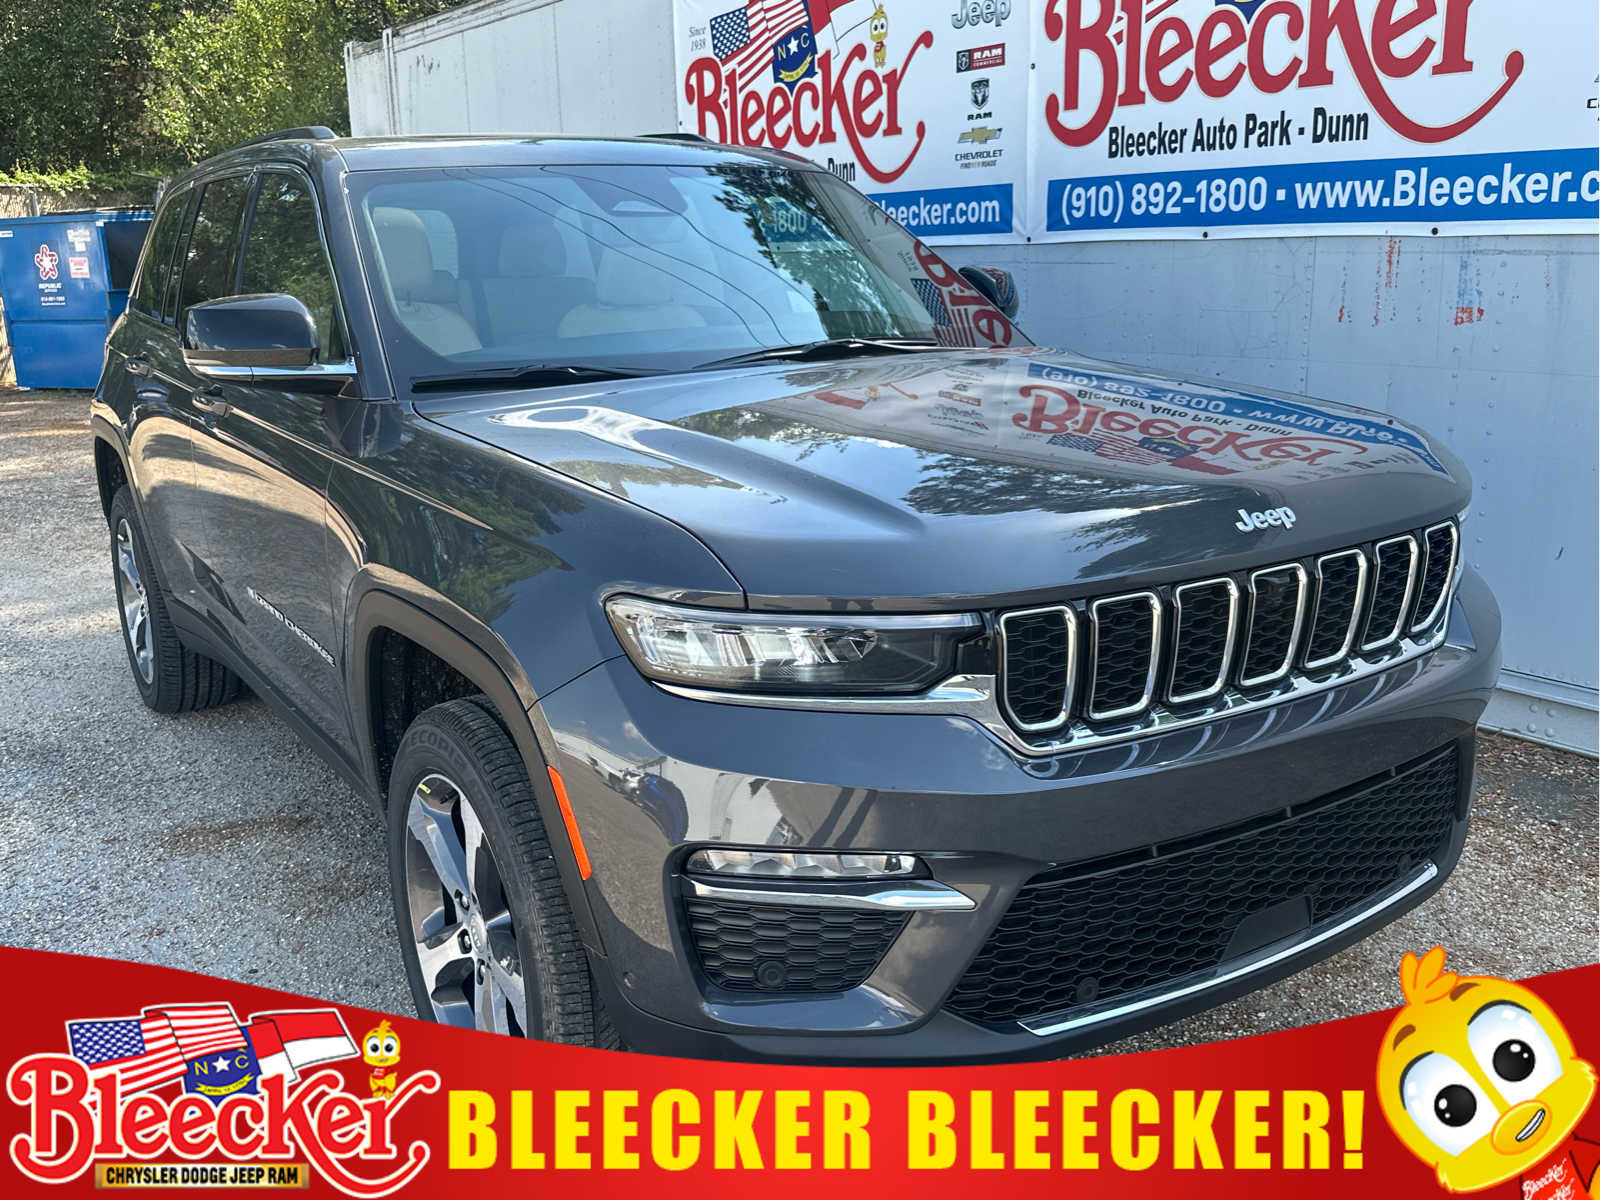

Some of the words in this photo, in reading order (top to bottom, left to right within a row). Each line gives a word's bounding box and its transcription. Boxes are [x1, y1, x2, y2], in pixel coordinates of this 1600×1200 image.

[951, 0, 1011, 29] Jeep
[973, 48, 1003, 60] RAM
[685, 31, 933, 184] Bleecker
[967, 112, 993, 121] RAM
[1108, 121, 1188, 159] Bleecker
[1191, 116, 1238, 152] Auto
[1244, 110, 1293, 148] Park
[1311, 106, 1370, 144] Dunn
[954, 149, 1004, 161] CHEVROLET
[827, 157, 856, 182] Dunn
[874, 197, 1001, 226] leecker.com
[1061, 180, 1125, 224] (910)
[1130, 176, 1268, 216] 892-1800
[1235, 506, 1297, 533] Jeep
